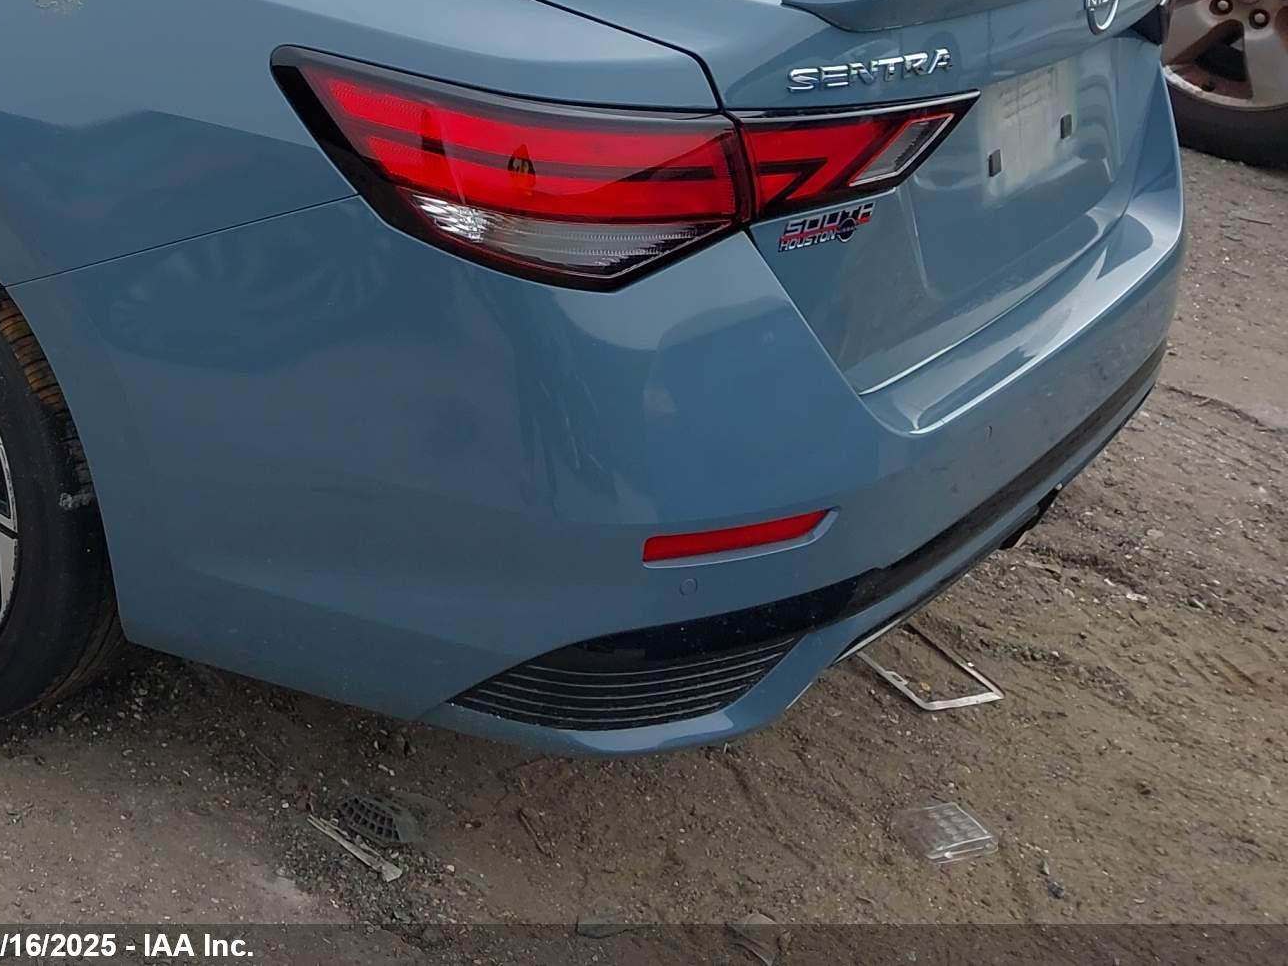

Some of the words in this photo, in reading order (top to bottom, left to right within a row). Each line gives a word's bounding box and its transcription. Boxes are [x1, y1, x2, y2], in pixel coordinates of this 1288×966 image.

[787, 48, 953, 92] SENTRA
[784, 202, 875, 236] SOUTH
[778, 230, 839, 252] HOUSTON
